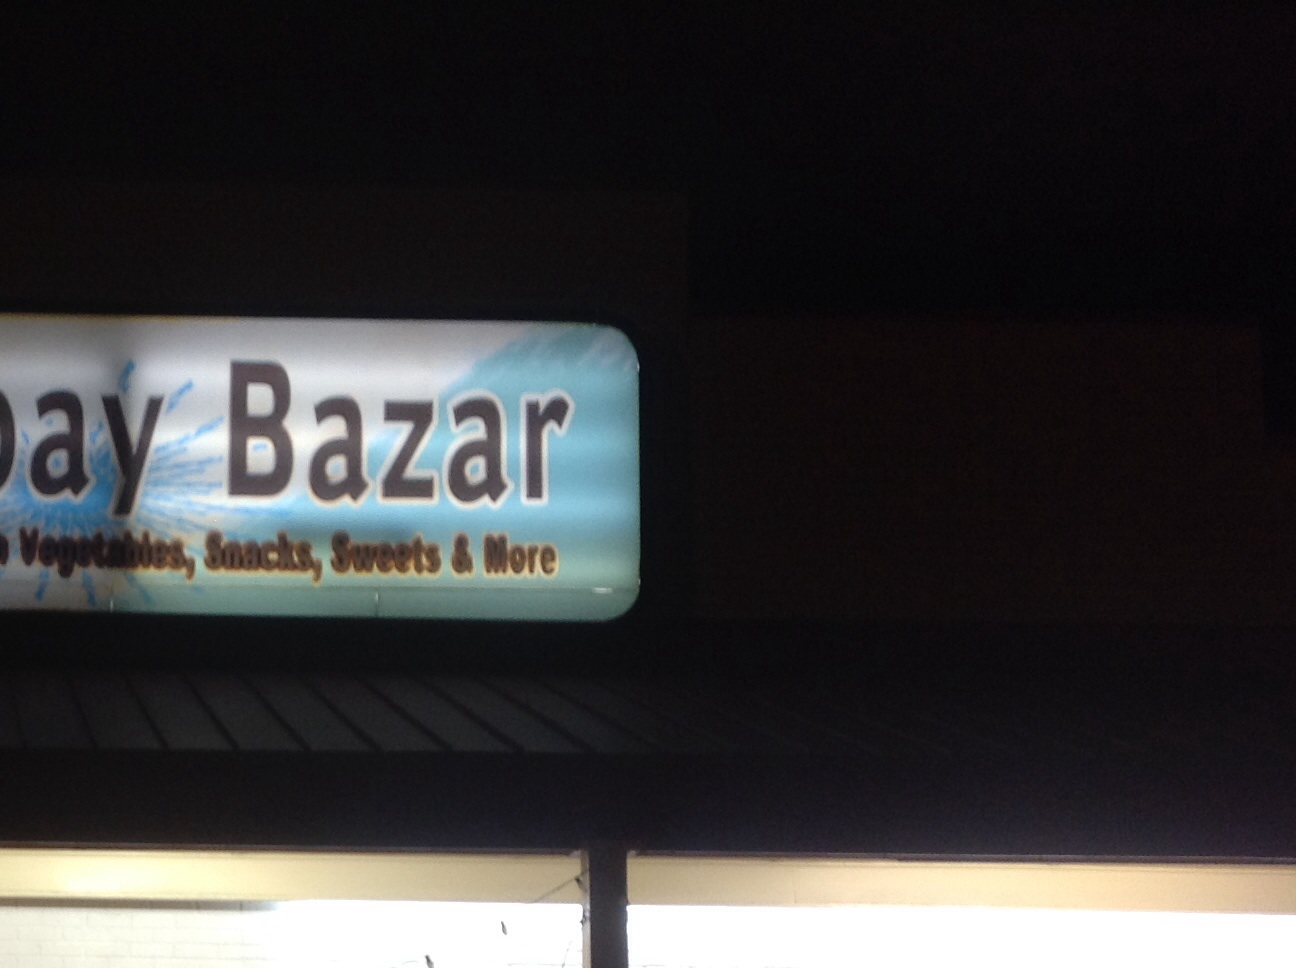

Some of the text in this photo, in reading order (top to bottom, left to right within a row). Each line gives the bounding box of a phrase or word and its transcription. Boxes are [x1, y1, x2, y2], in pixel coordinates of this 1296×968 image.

[228, 360, 571, 502] Bazar
[19, 526, 195, 580] Vegetables,
[204, 530, 322, 582] Snacks,
[330, 530, 442, 575] Sweets
[451, 532, 473, 575] &
[483, 533, 557, 576] More
